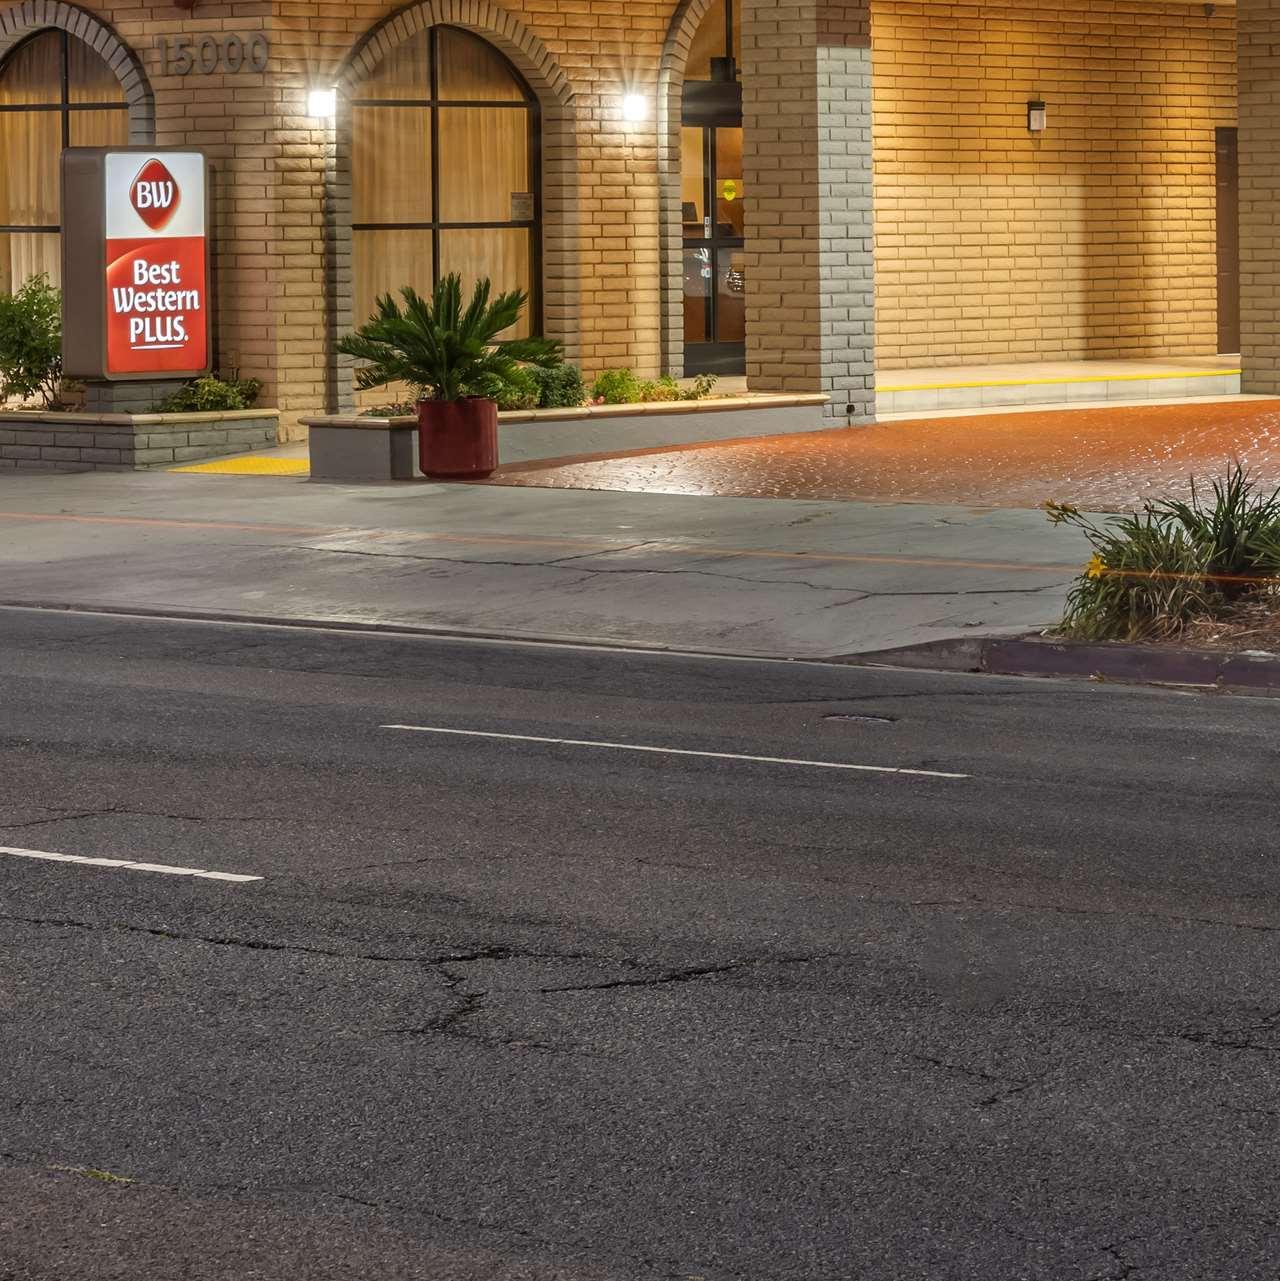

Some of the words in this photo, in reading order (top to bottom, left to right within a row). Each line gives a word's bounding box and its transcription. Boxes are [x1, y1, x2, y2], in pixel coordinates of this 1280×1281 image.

[158, 33, 269, 76] 15000
[136, 181, 173, 209] BW
[133, 259, 181, 285] Best
[112, 287, 200, 313] Western
